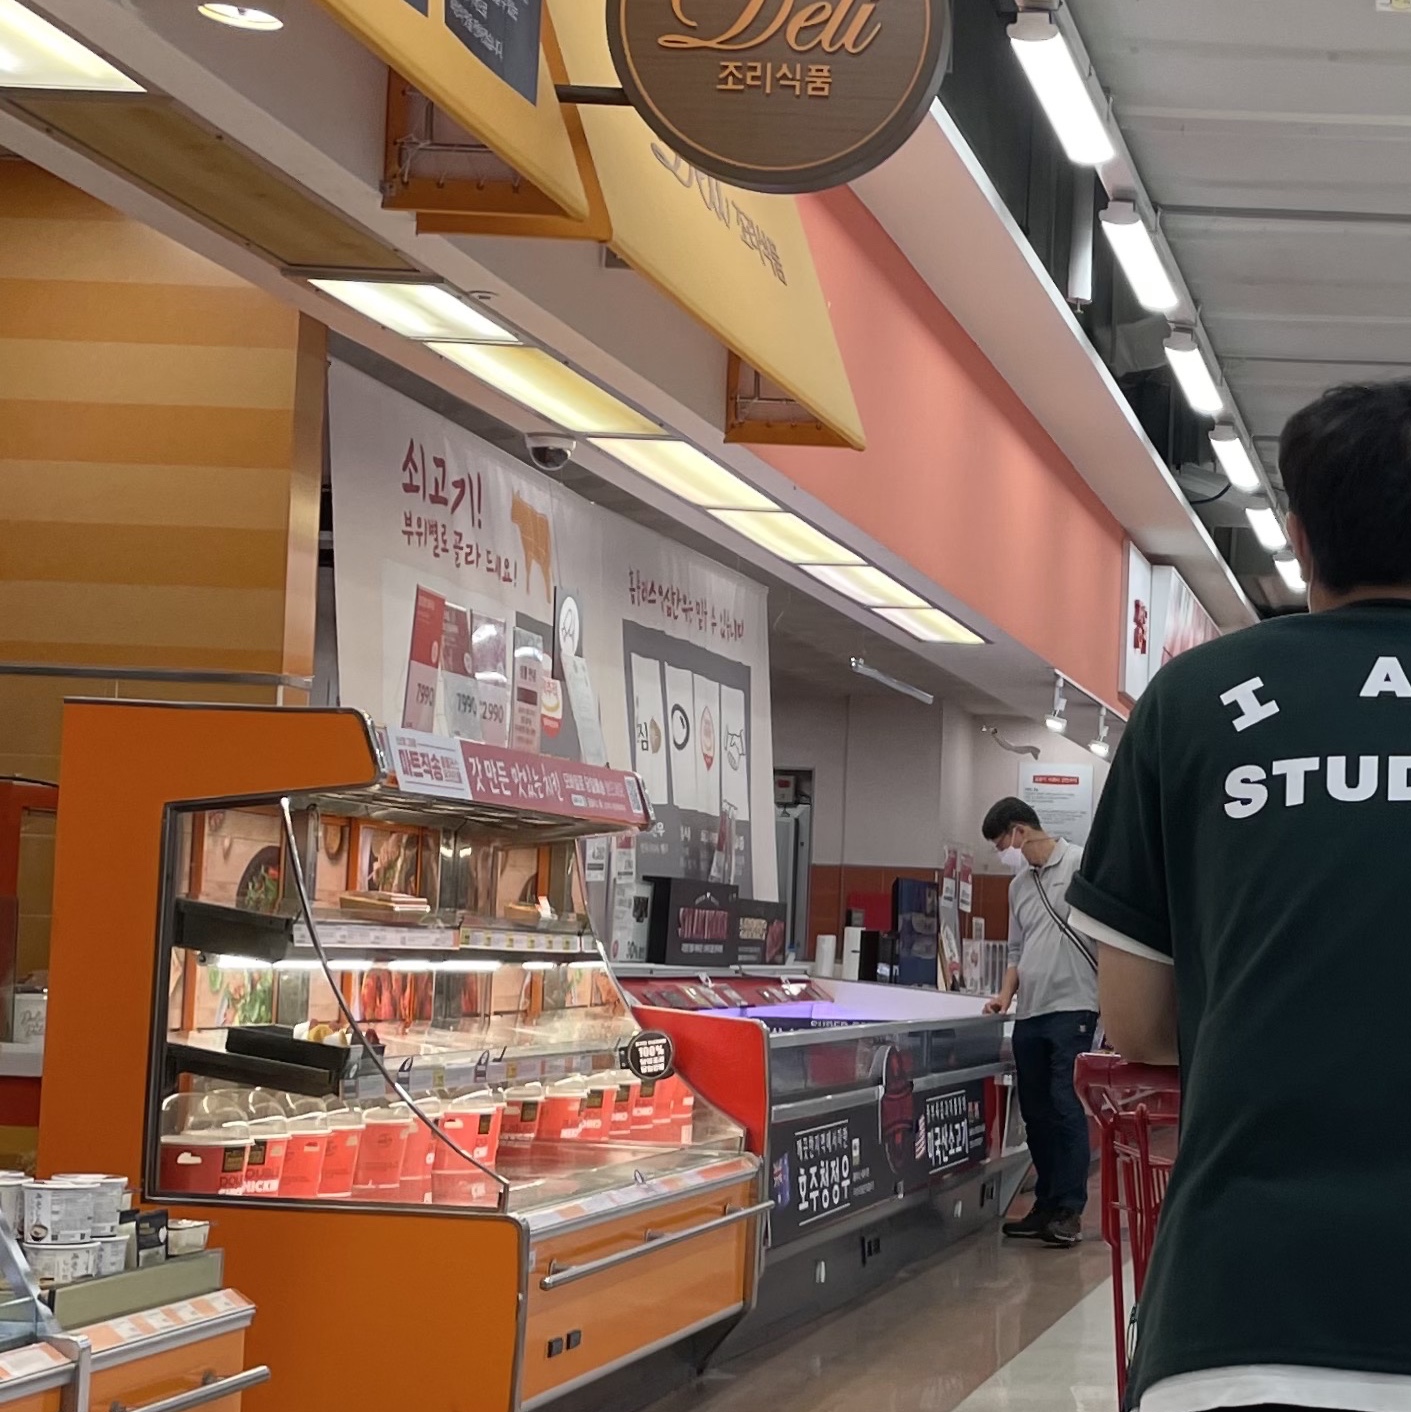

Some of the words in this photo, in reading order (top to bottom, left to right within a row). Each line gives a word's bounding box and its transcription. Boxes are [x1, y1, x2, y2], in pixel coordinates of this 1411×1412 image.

[656, 0, 882, 53] Deli
[716, 61, 833, 97] 조리식품
[401, 438, 482, 530] 쇠고기!
[401, 510, 449, 558] 부위별로
[453, 530, 481, 569] 골라
[486, 549, 518, 588] 드세요!
[638, 1044, 665, 1058] 100%
[798, 1155, 851, 1212] 호주청정우
